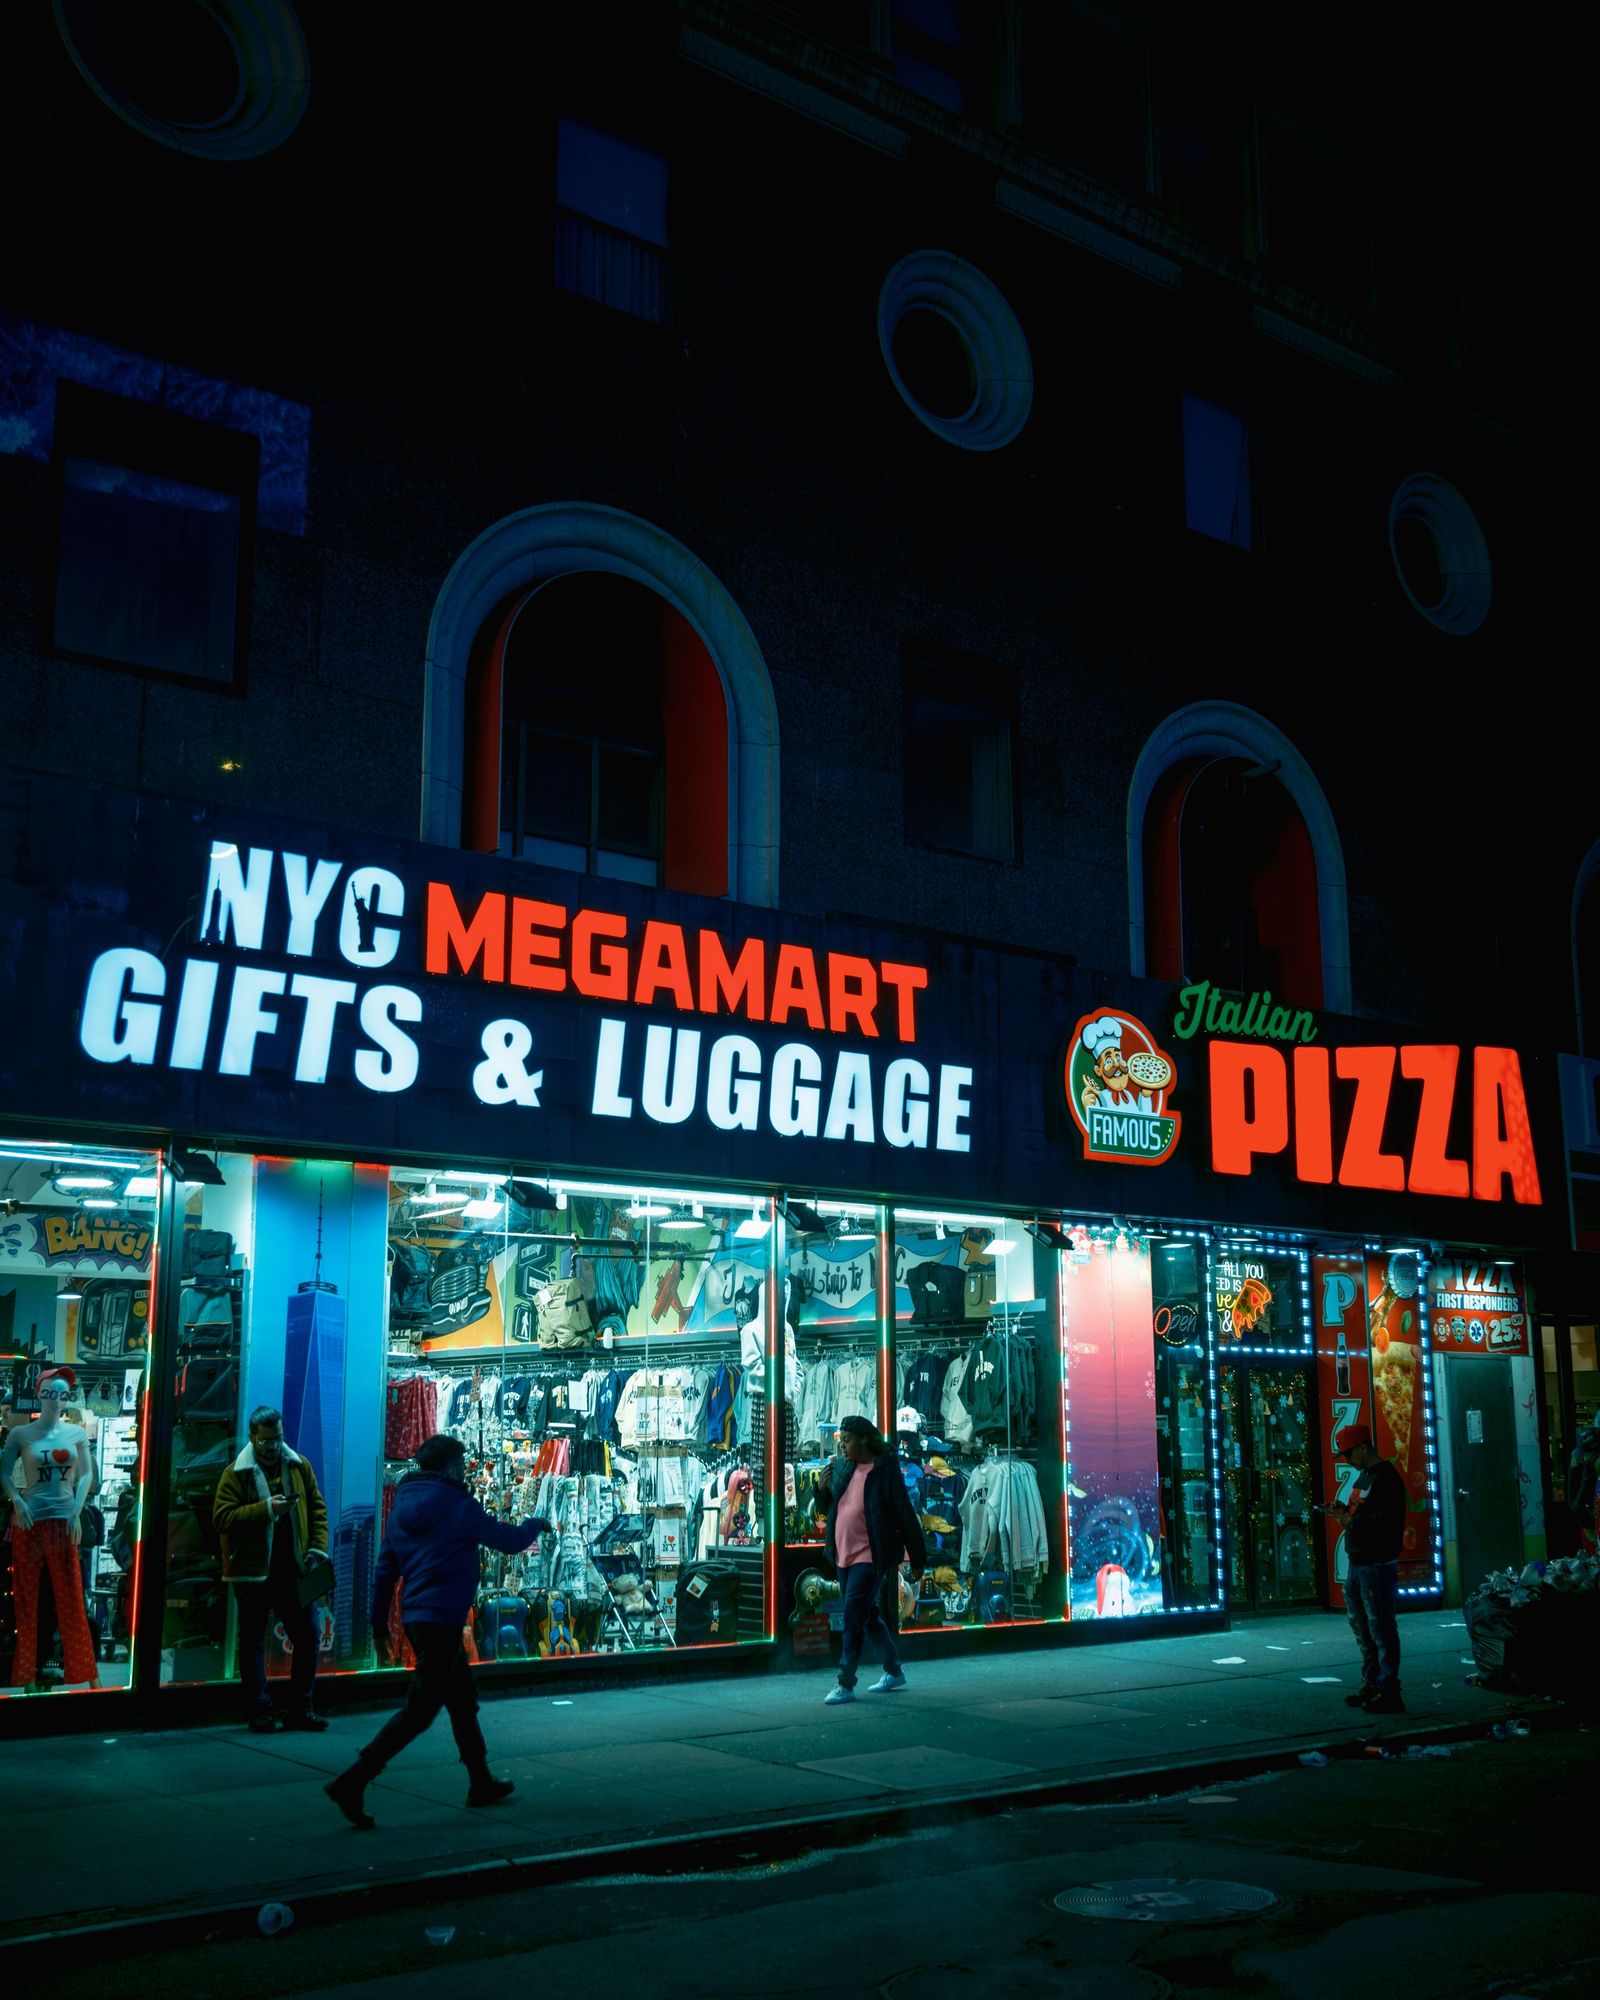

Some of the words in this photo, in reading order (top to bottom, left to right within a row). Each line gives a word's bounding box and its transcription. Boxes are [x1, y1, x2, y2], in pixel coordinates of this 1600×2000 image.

[201, 841, 405, 968] NYC
[425, 881, 928, 1042] MEGAMART
[1173, 980, 1318, 1043] Italian
[80, 947, 423, 1093] GIFTS
[472, 1018, 543, 1107] &
[592, 1018, 973, 1152] LUGGAGE
[1092, 1113, 1161, 1151] FAMOUS
[1209, 1040, 1542, 1205] PIZZA
[45, 1217, 149, 1259] BANG!
[823, 1263, 847, 1303] trip
[848, 1262, 863, 1291] to
[1224, 1261, 1241, 1277] ALL
[1245, 1263, 1263, 1279] YOU
[1436, 1259, 1516, 1294] PIZZA
[1233, 1279, 1241, 1292] IS
[1437, 1293, 1462, 1308] FIRST
[1464, 1294, 1519, 1312] RESPONDERS
[1155, 1308, 1197, 1334] Open
[1490, 1318, 1521, 1344] 25%
[41, 1450, 51, 1465] I
[37, 1466, 71, 1482] NY
[662, 1543, 676, 1551] NY
